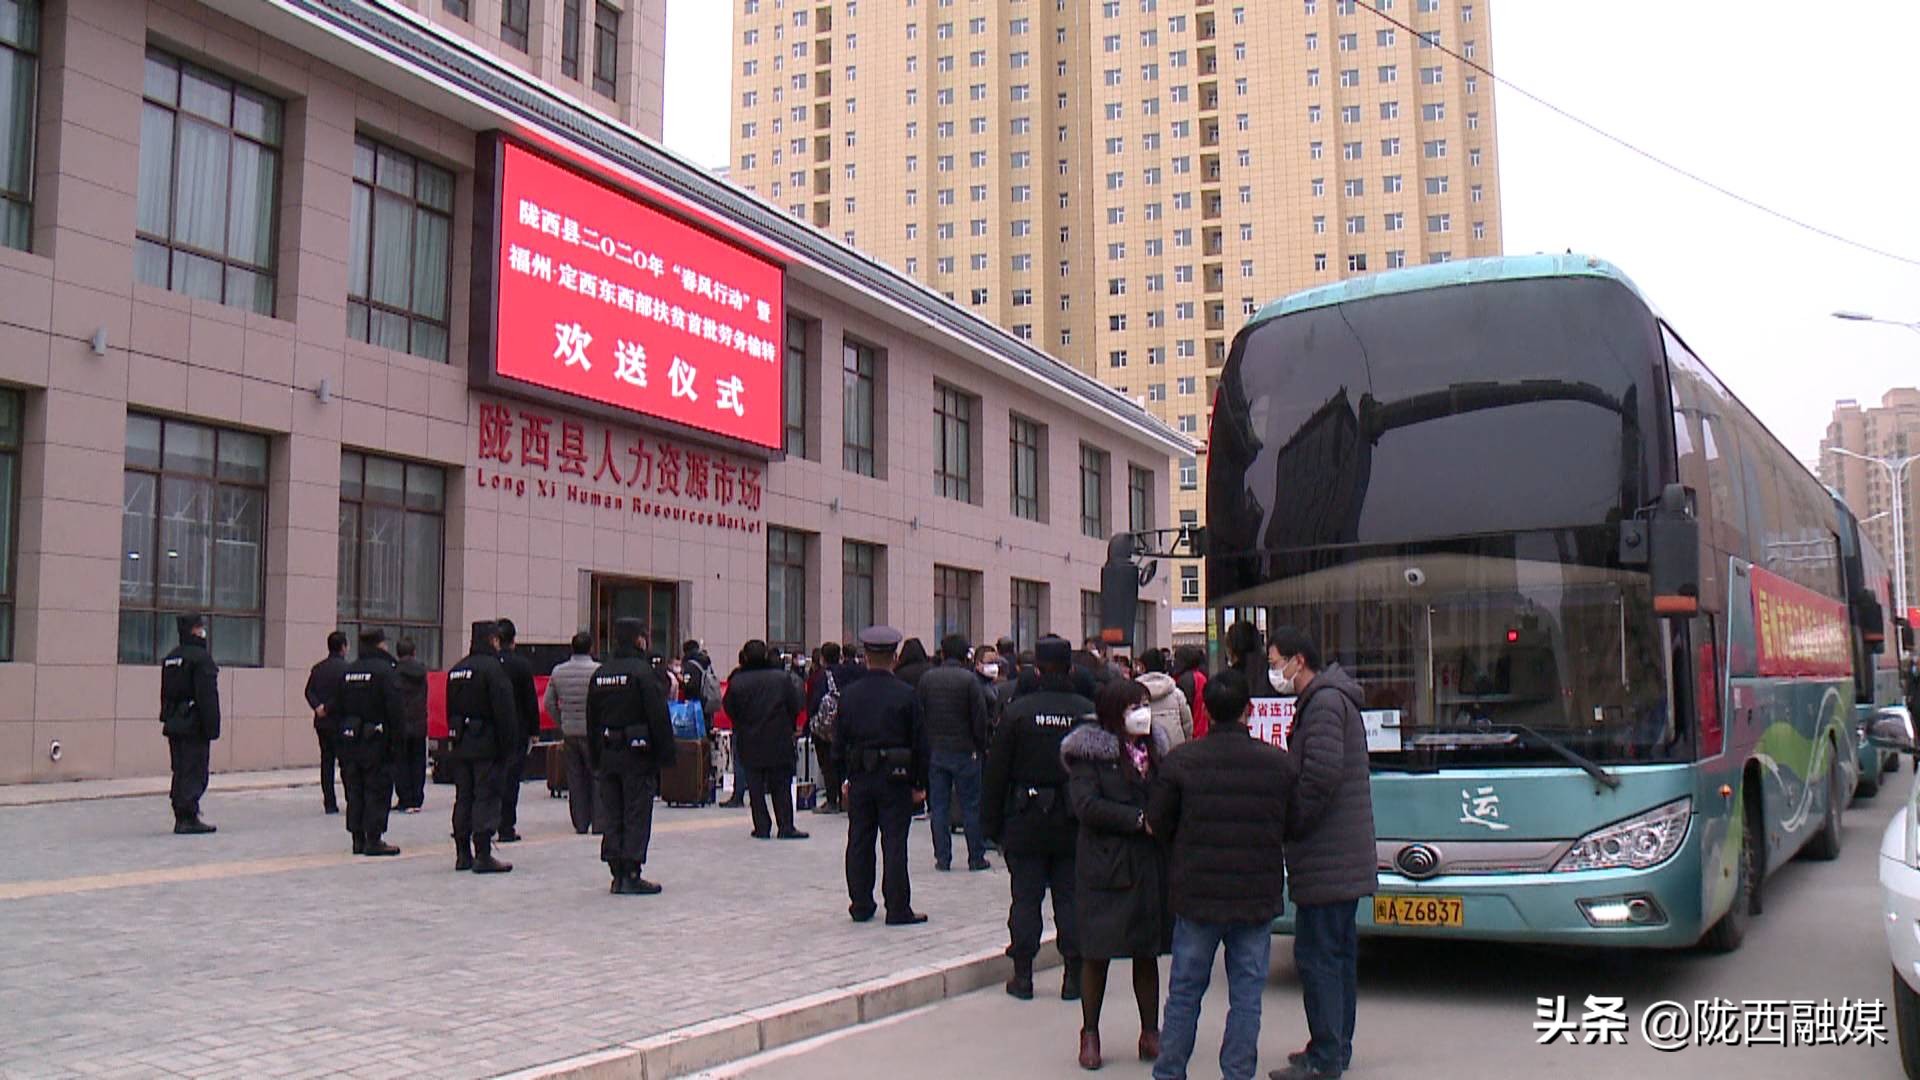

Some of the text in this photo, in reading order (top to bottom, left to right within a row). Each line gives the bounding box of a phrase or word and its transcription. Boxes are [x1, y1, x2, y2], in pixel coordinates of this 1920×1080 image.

[553, 322, 745, 417] 欢送仪式
[478, 403, 762, 512] 陇西县人力资源市场
[478, 468, 761, 534] Long Xi Human Resources Market
[1459, 785, 1511, 831] 运
